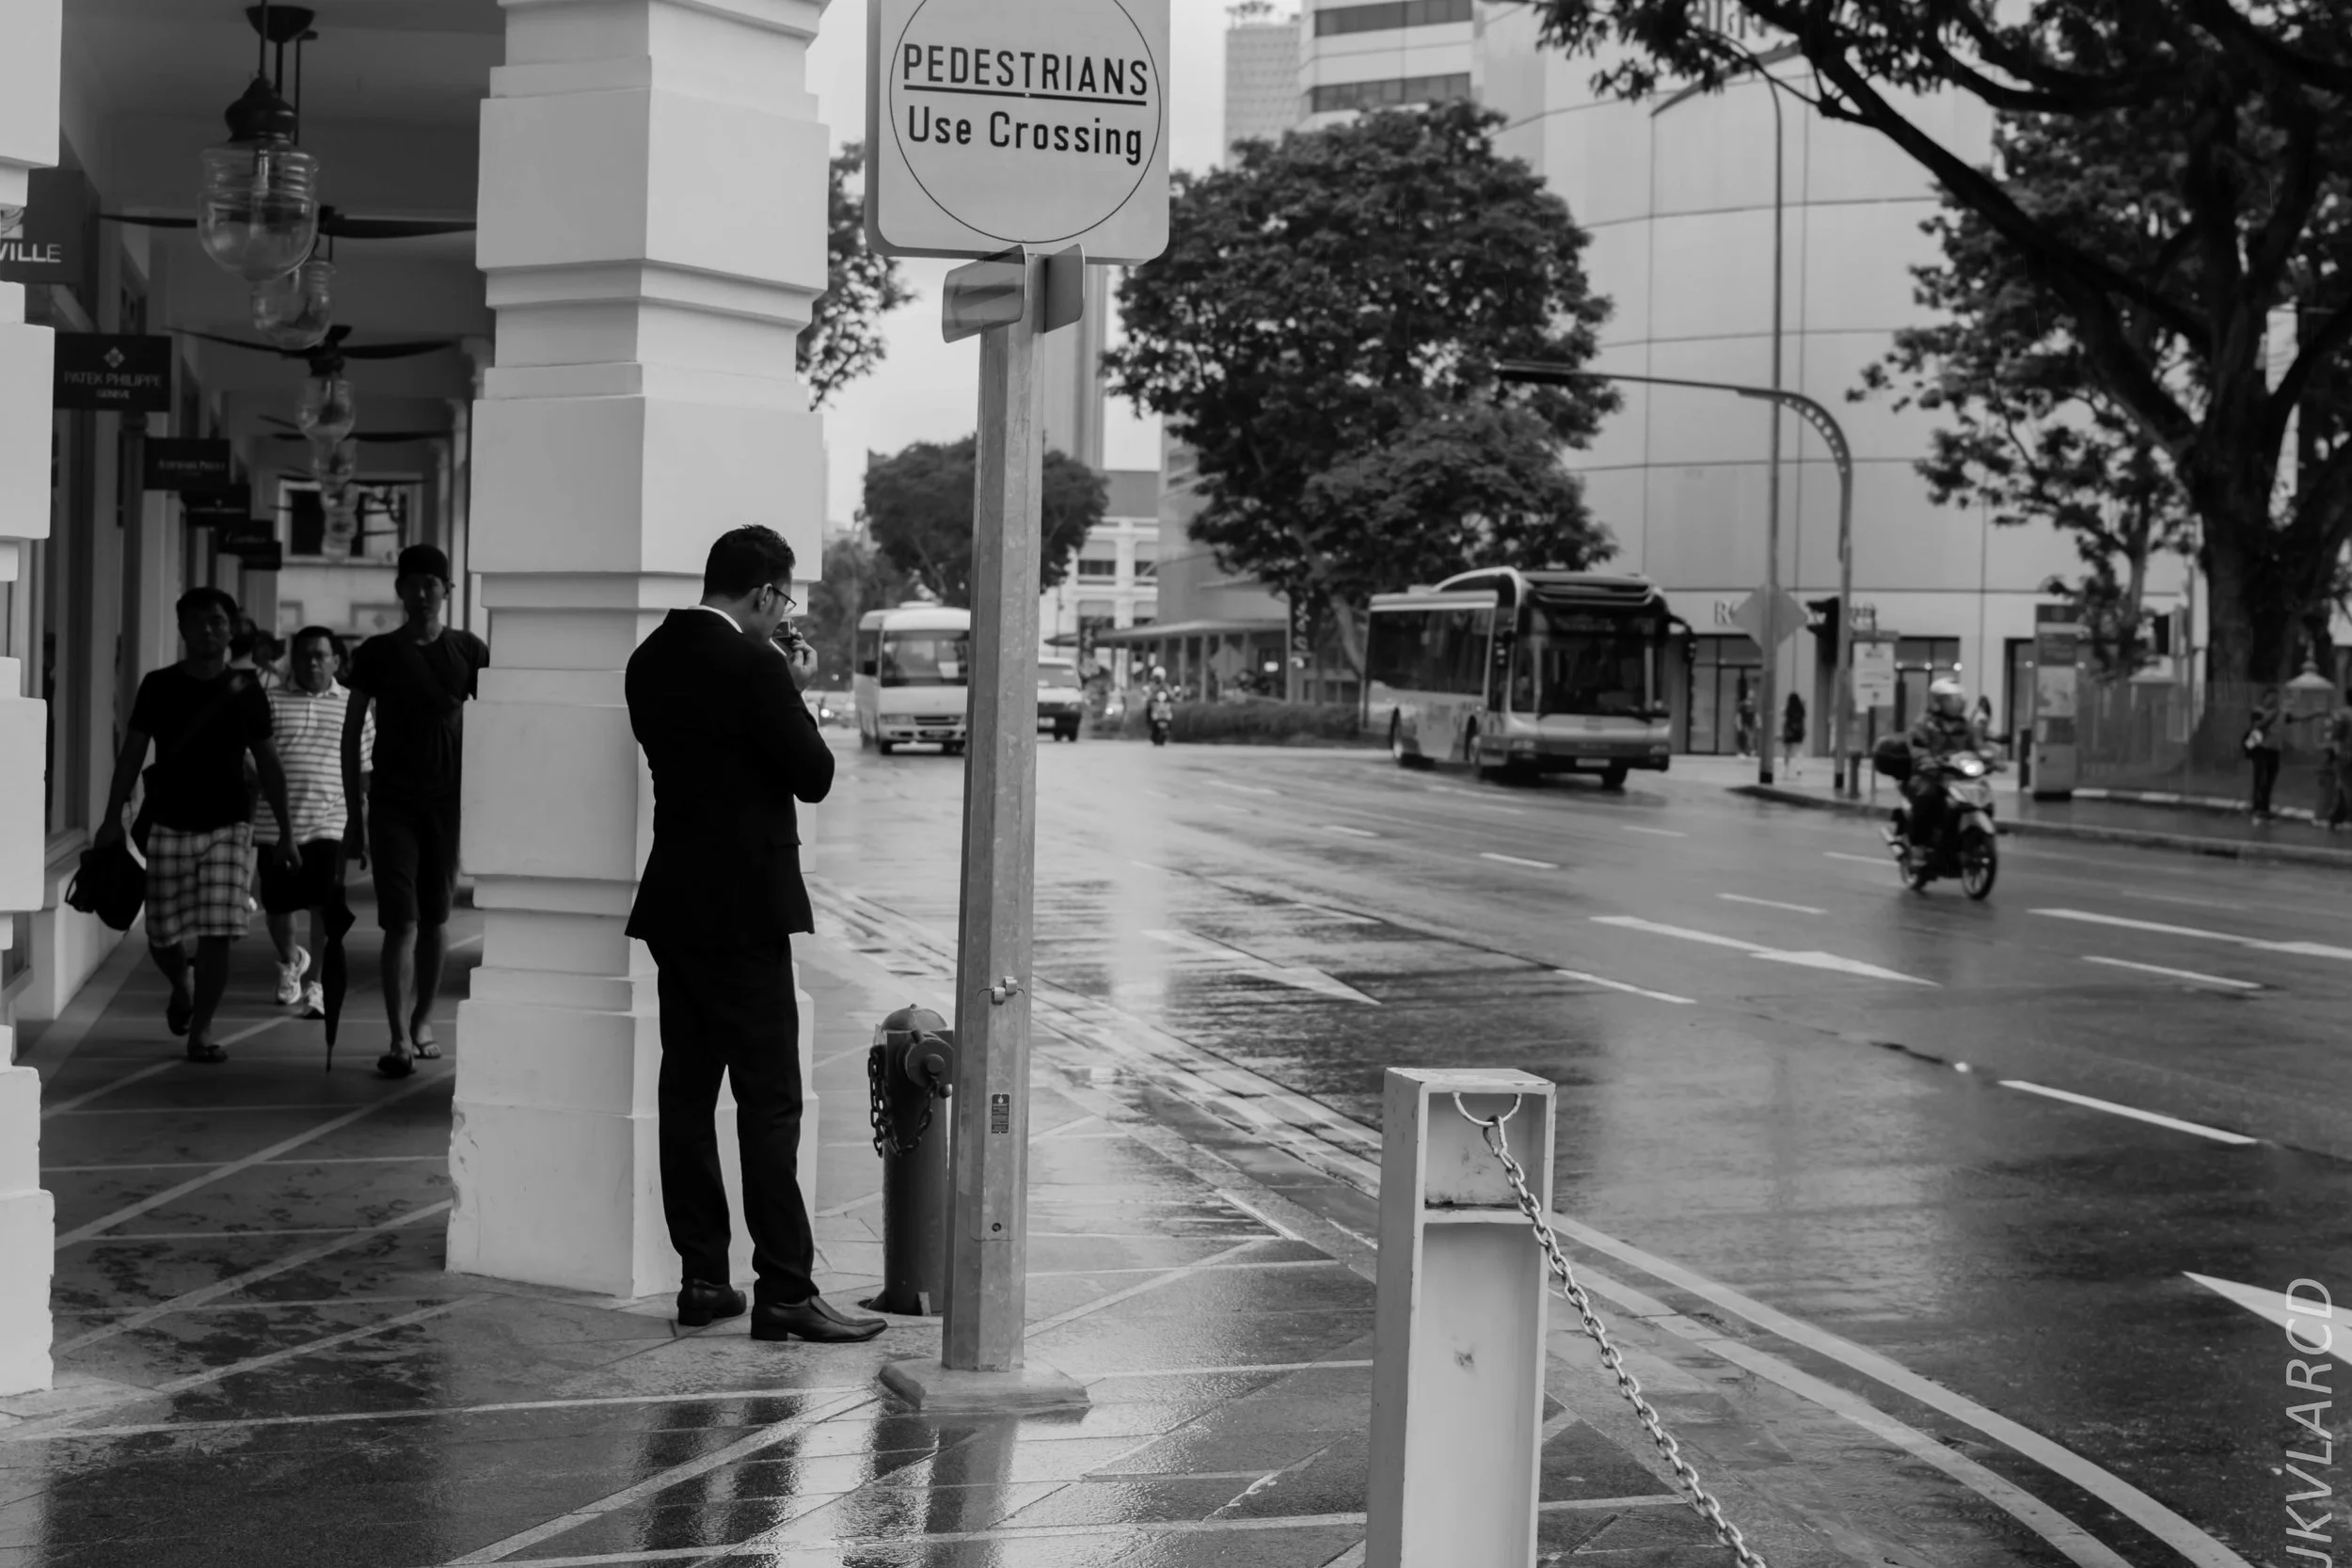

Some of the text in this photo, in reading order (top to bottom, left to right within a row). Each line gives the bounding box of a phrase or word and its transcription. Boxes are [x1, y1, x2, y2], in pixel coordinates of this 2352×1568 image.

[903, 42, 1148, 96] PEDESTRIANS
[909, 105, 1141, 166] Use Crossing
